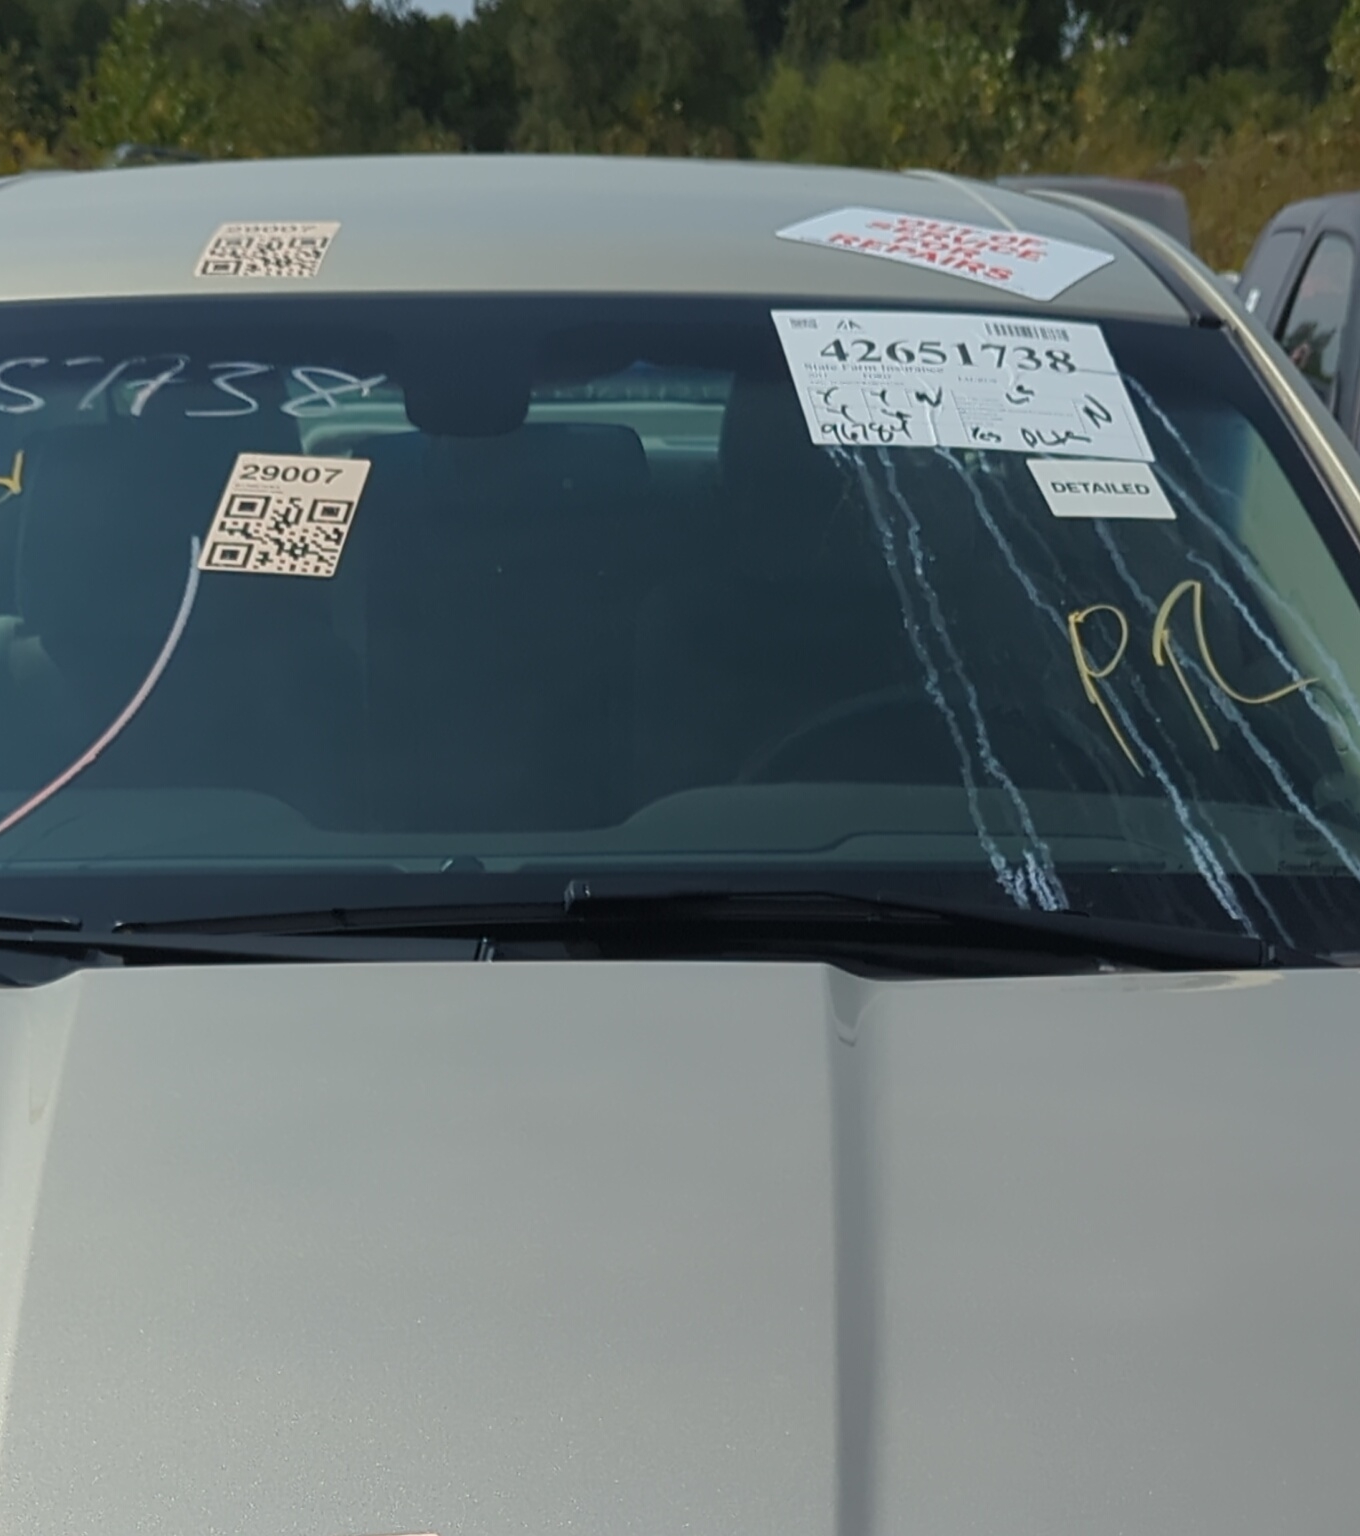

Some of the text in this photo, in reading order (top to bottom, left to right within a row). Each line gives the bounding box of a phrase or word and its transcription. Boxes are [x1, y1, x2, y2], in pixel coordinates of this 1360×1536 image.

[828, 231, 1014, 282] REPAIRS
[819, 337, 1077, 374] 42651738
[240, 464, 343, 485] 29007
[1051, 480, 1151, 497] DETAILED
